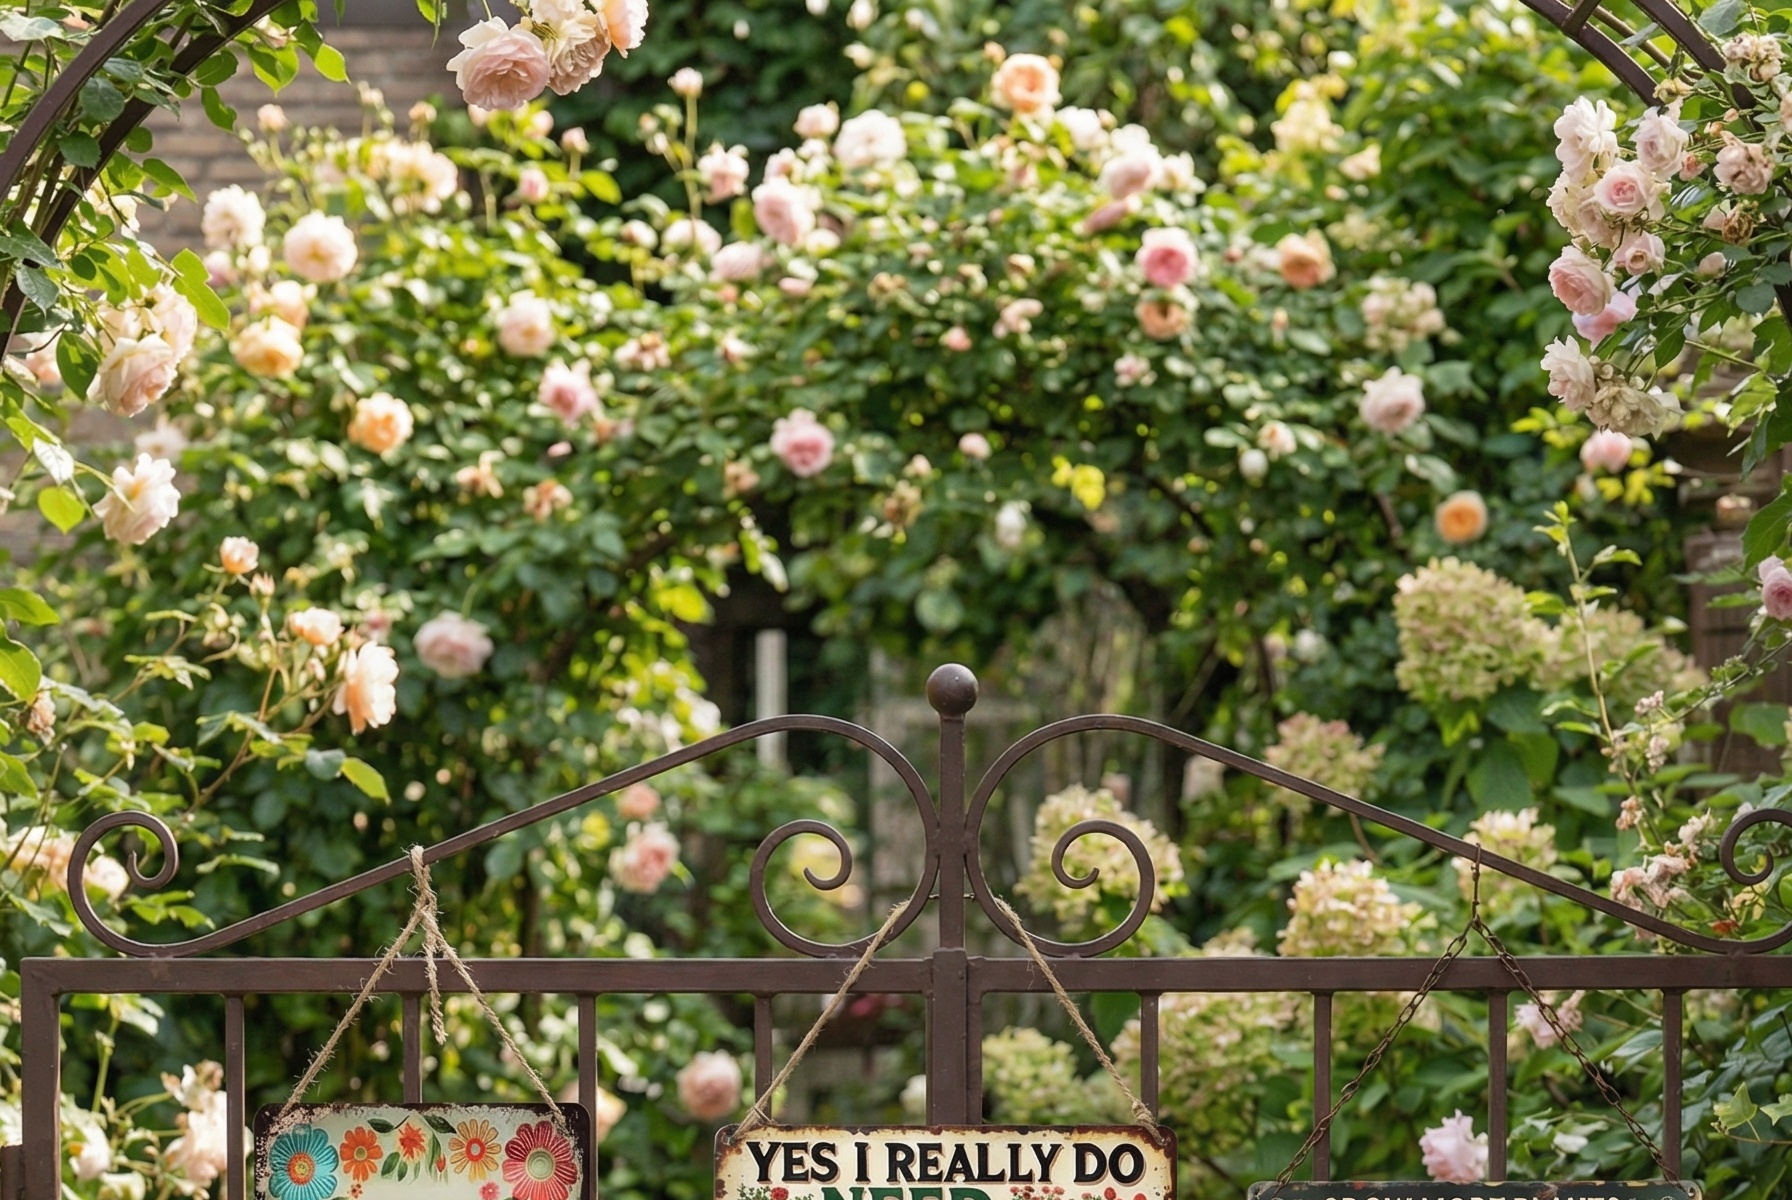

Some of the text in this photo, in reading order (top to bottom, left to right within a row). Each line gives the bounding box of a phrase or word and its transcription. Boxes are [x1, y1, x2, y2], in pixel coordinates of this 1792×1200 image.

[746, 1141, 1146, 1185] YES I REALLY DO
